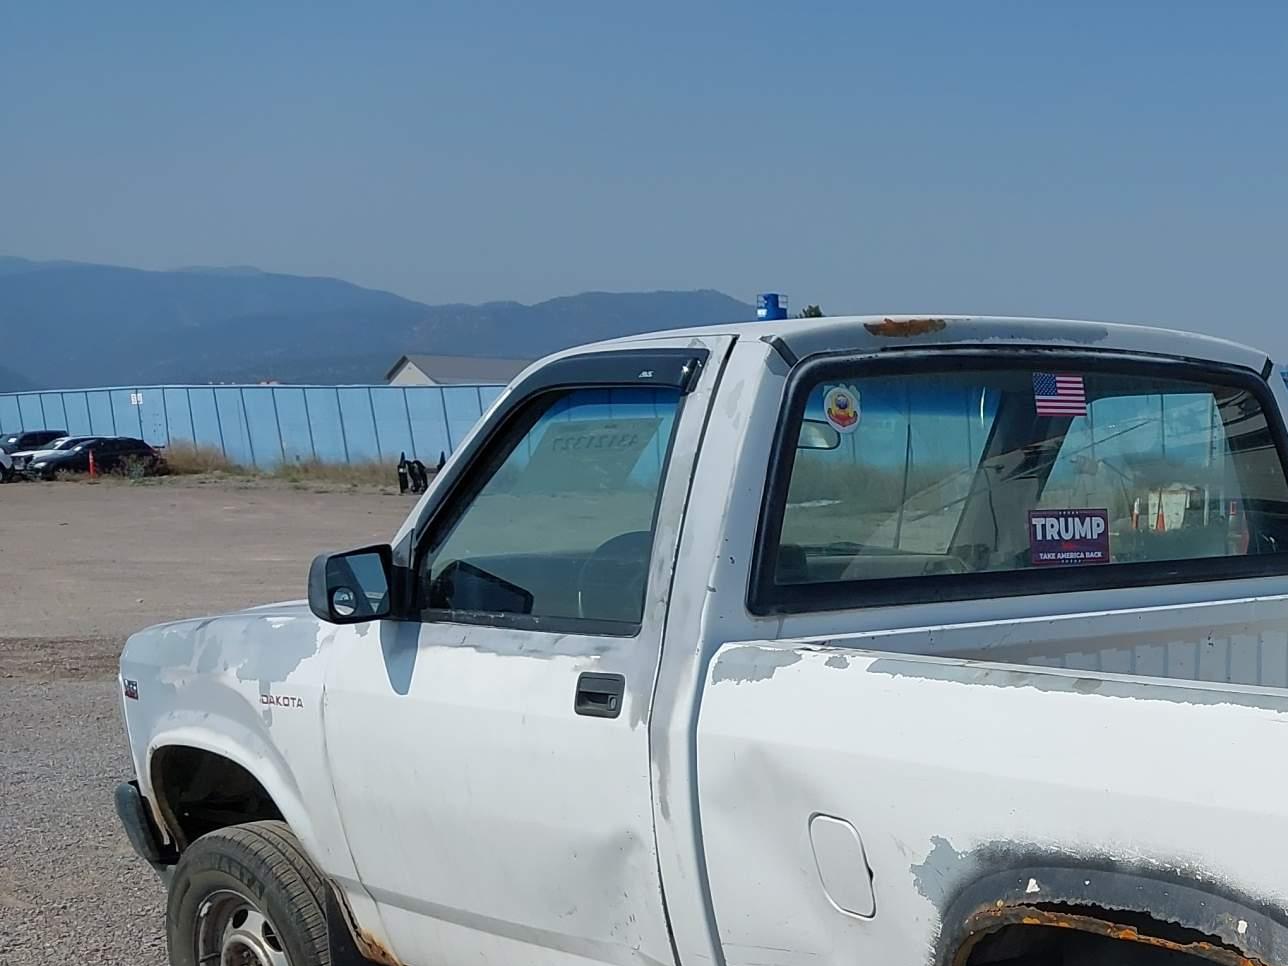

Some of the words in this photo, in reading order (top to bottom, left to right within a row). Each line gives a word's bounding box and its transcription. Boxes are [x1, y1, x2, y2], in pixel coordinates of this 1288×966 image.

[1031, 516, 1105, 541] TRUMP
[1040, 552, 1056, 560] TAKE
[1057, 551, 1085, 559] AMERICA
[1086, 551, 1102, 559] BACK
[261, 694, 304, 708] DAKOTA
